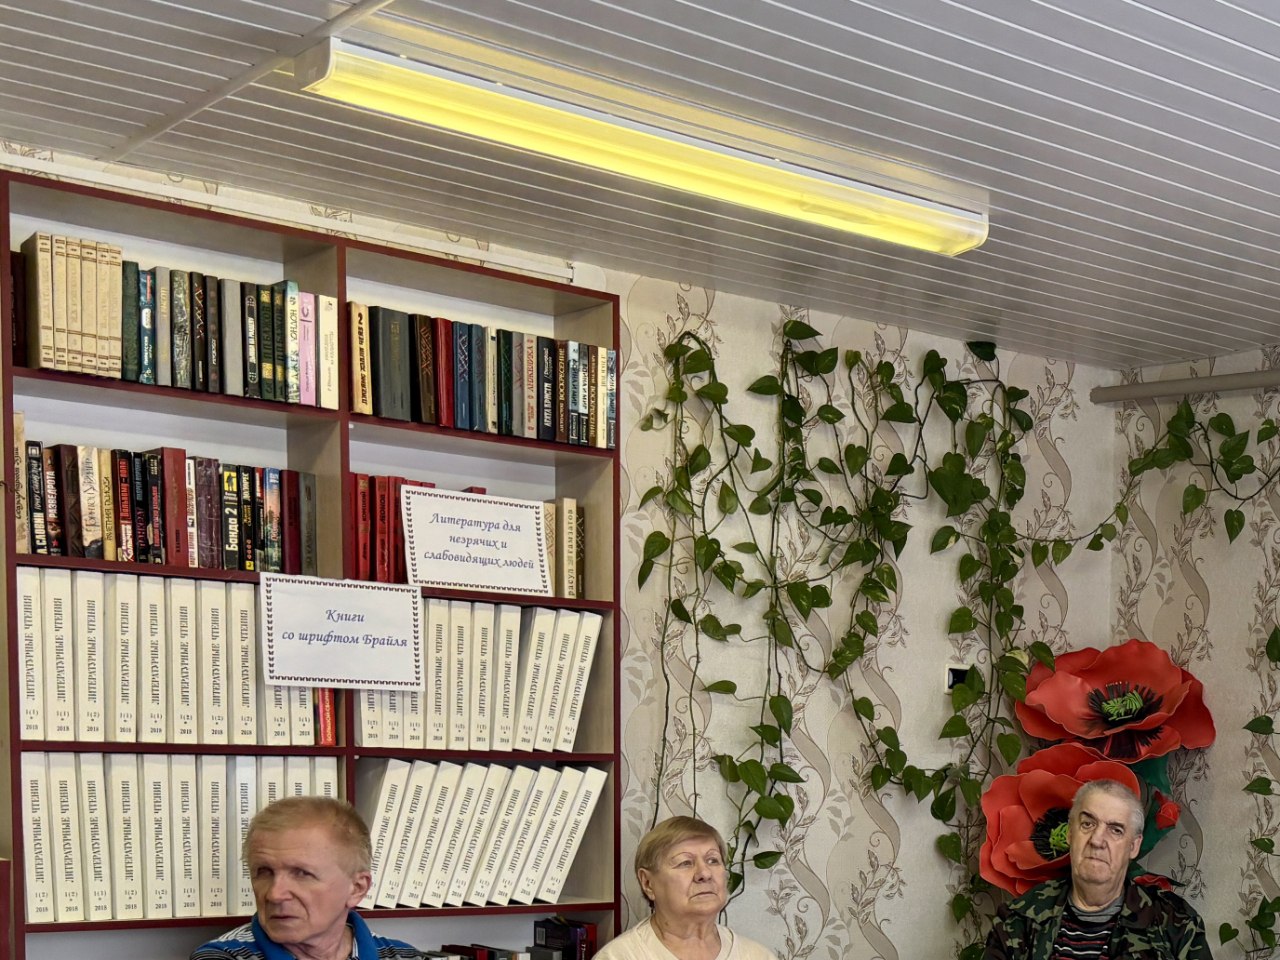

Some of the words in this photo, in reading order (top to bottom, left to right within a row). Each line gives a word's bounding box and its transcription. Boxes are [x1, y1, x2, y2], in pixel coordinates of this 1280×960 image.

[46, 470, 58, 519] РАЗВЕДРОТА
[33, 512, 47, 546] СЛОВИН
[226, 517, 239, 552] Банда
[428, 513, 500, 532] Литература
[502, 519, 521, 532] для
[449, 535, 500, 550] незрячих
[501, 540, 507, 549] и
[566, 508, 575, 555] гамзатов
[424, 549, 503, 568] слабовидящих
[503, 558, 534, 569] людей
[567, 568, 575, 596] расул
[23, 594, 33, 630] ЧТЕНИЯ
[53, 597, 63, 632] ЧТЕНИЯ
[86, 599, 96, 634] ЧТЕНИЯ
[120, 602, 129, 636] ЧТЕНИЯ
[149, 603, 158, 637] ЧТЕНИЯ
[179, 606, 188, 639] ЧТЕНИЯ
[211, 607, 220, 641] ЧТЕНИЯ
[240, 609, 249, 642] ЧТЕНИЯ
[326, 610, 365, 623] Книги
[435, 623, 443, 654] ЧТЕНИЯ
[282, 631, 295, 640] со
[298, 631, 360, 645] шрифтом
[362, 634, 408, 648] Брайля
[480, 626, 488, 657] ЧТЕНИЯ
[504, 629, 513, 658] ЧТЕНИЯ
[24, 632, 36, 701] ЛИТЕРАТУРНЫЕ
[55, 634, 66, 703] ЛИТЕРАТУРНЫЕ
[87, 636, 97, 703] ЛИТЕРАТУРНЫЕ
[120, 638, 130, 705] ЛИТЕРАТУРНЫЕ
[150, 639, 160, 705] ЛИТЕРАТУРНЫЕ
[180, 641, 190, 706] ЛИТЕРАТУРНЫЕ
[212, 643, 221, 708] ЛИТЕРАТУРНЫЕ
[241, 644, 250, 708] ЛИТЕРАТУРНЫЕ
[434, 656, 442, 716] ЛИТЕРАТУРНЫЕ
[456, 658, 464, 716] ЛИТЕРАТУРНЫЕ
[478, 659, 487, 717] ЛИТЕРАТУРНЫЕ
[502, 661, 512, 719] ЛИТЕРАТУРНЫЕ
[526, 662, 541, 719] ЛИТЕРАТУРНЫЕ
[535, 631, 546, 661] ЧТЕНИЯ
[548, 664, 564, 719] ЛИТЕРАТУРНЫЕ
[559, 633, 570, 662] ЧТЕНИЯ
[568, 665, 586, 721] ЛИТЕРАТУРНЫЕ
[580, 635, 592, 663] ЧТЕНИЯ
[30, 779, 39, 814] ЧТЕНИЯ
[59, 780, 68, 814] ЧТЕНИЯ
[87, 780, 96, 814] ЧТЕНИЯ
[121, 780, 131, 814] ЧТЕНИЯ
[152, 781, 162, 814] ЧТЕНИЯ
[180, 780, 190, 814] ЧТЕНИЯ
[211, 781, 220, 814] ЧТЕНИЯ
[240, 782, 249, 815] ЧТЕНИЯ
[384, 783, 398, 813] ЧТЕНИЯ
[32, 816, 45, 884] ЛИТЕРАТУРНЫЕ
[61, 817, 74, 883] ЛИТЕРАТУРНЫЕ
[89, 817, 103, 882] ЛИТЕРАТУРНЫЕ
[122, 816, 134, 882] ЛИТЕРАТУРНЫЕ
[154, 817, 164, 881] ЛИТЕРАТУРНЫЕ
[182, 816, 192, 880] ЛИТЕРАТУРНЫЕ
[211, 817, 220, 880] ЛИТЕРАТУРНЫЕ
[393, 816, 415, 875] ЛИТЕРАТУРНЫЕ
[408, 784, 423, 814] ЧТЕНИЯ
[417, 816, 440, 875] ЛИТЕРАТУРНЫЕ
[432, 785, 449, 814] ЧТЕНИЯ
[440, 817, 464, 875] ЛИТЕРАТУРНЫЕ
[457, 787, 475, 816] ЧТЕНИЯ
[460, 817, 484, 874] ЛИТЕРАТУРНЫЕ
[479, 787, 494, 816] ЧТЕНИЯ
[484, 818, 510, 874] ЛИТЕРАТУРНЫЕ
[504, 789, 521, 817] ЧТЕНИЯ
[508, 819, 533, 874] ЛИТЕРАТУРНЫЕ
[527, 789, 544, 817] ЧТЕНИЯ
[531, 818, 557, 873] ЛИТЕРАТУРНЫЕ
[551, 790, 569, 817] ЧТЕНИЯ
[556, 818, 581, 872] ЛИТЕРАТУРНЫЕ
[576, 789, 593, 817] ЧТЕНИЯ
